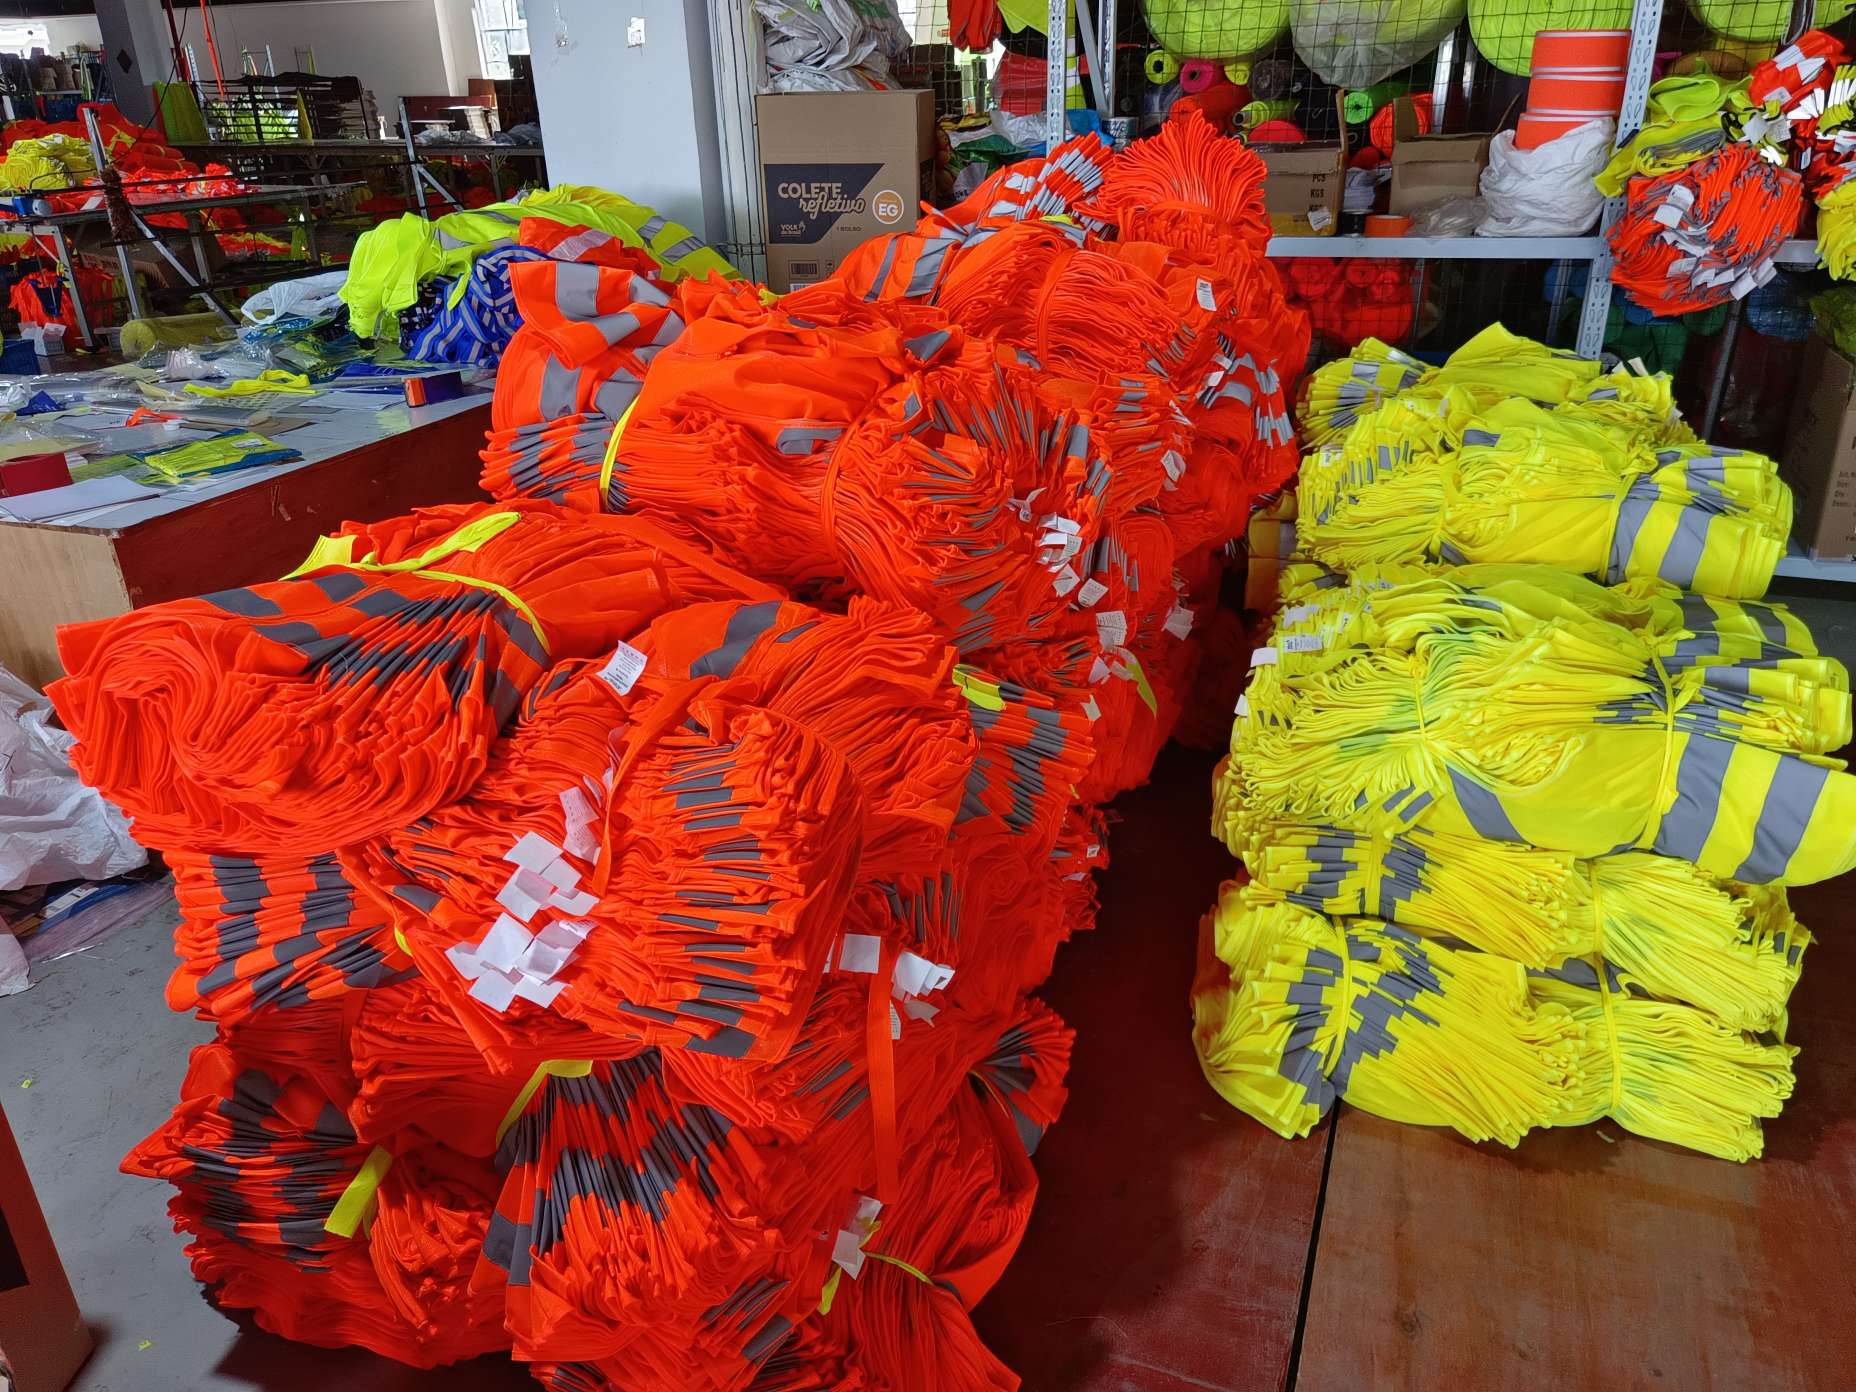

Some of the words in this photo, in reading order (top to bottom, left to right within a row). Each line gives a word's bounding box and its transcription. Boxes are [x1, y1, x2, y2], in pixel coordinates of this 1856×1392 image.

[778, 182, 842, 198] COLETE
[799, 191, 866, 219] refletivo
[878, 203, 899, 216] EG
